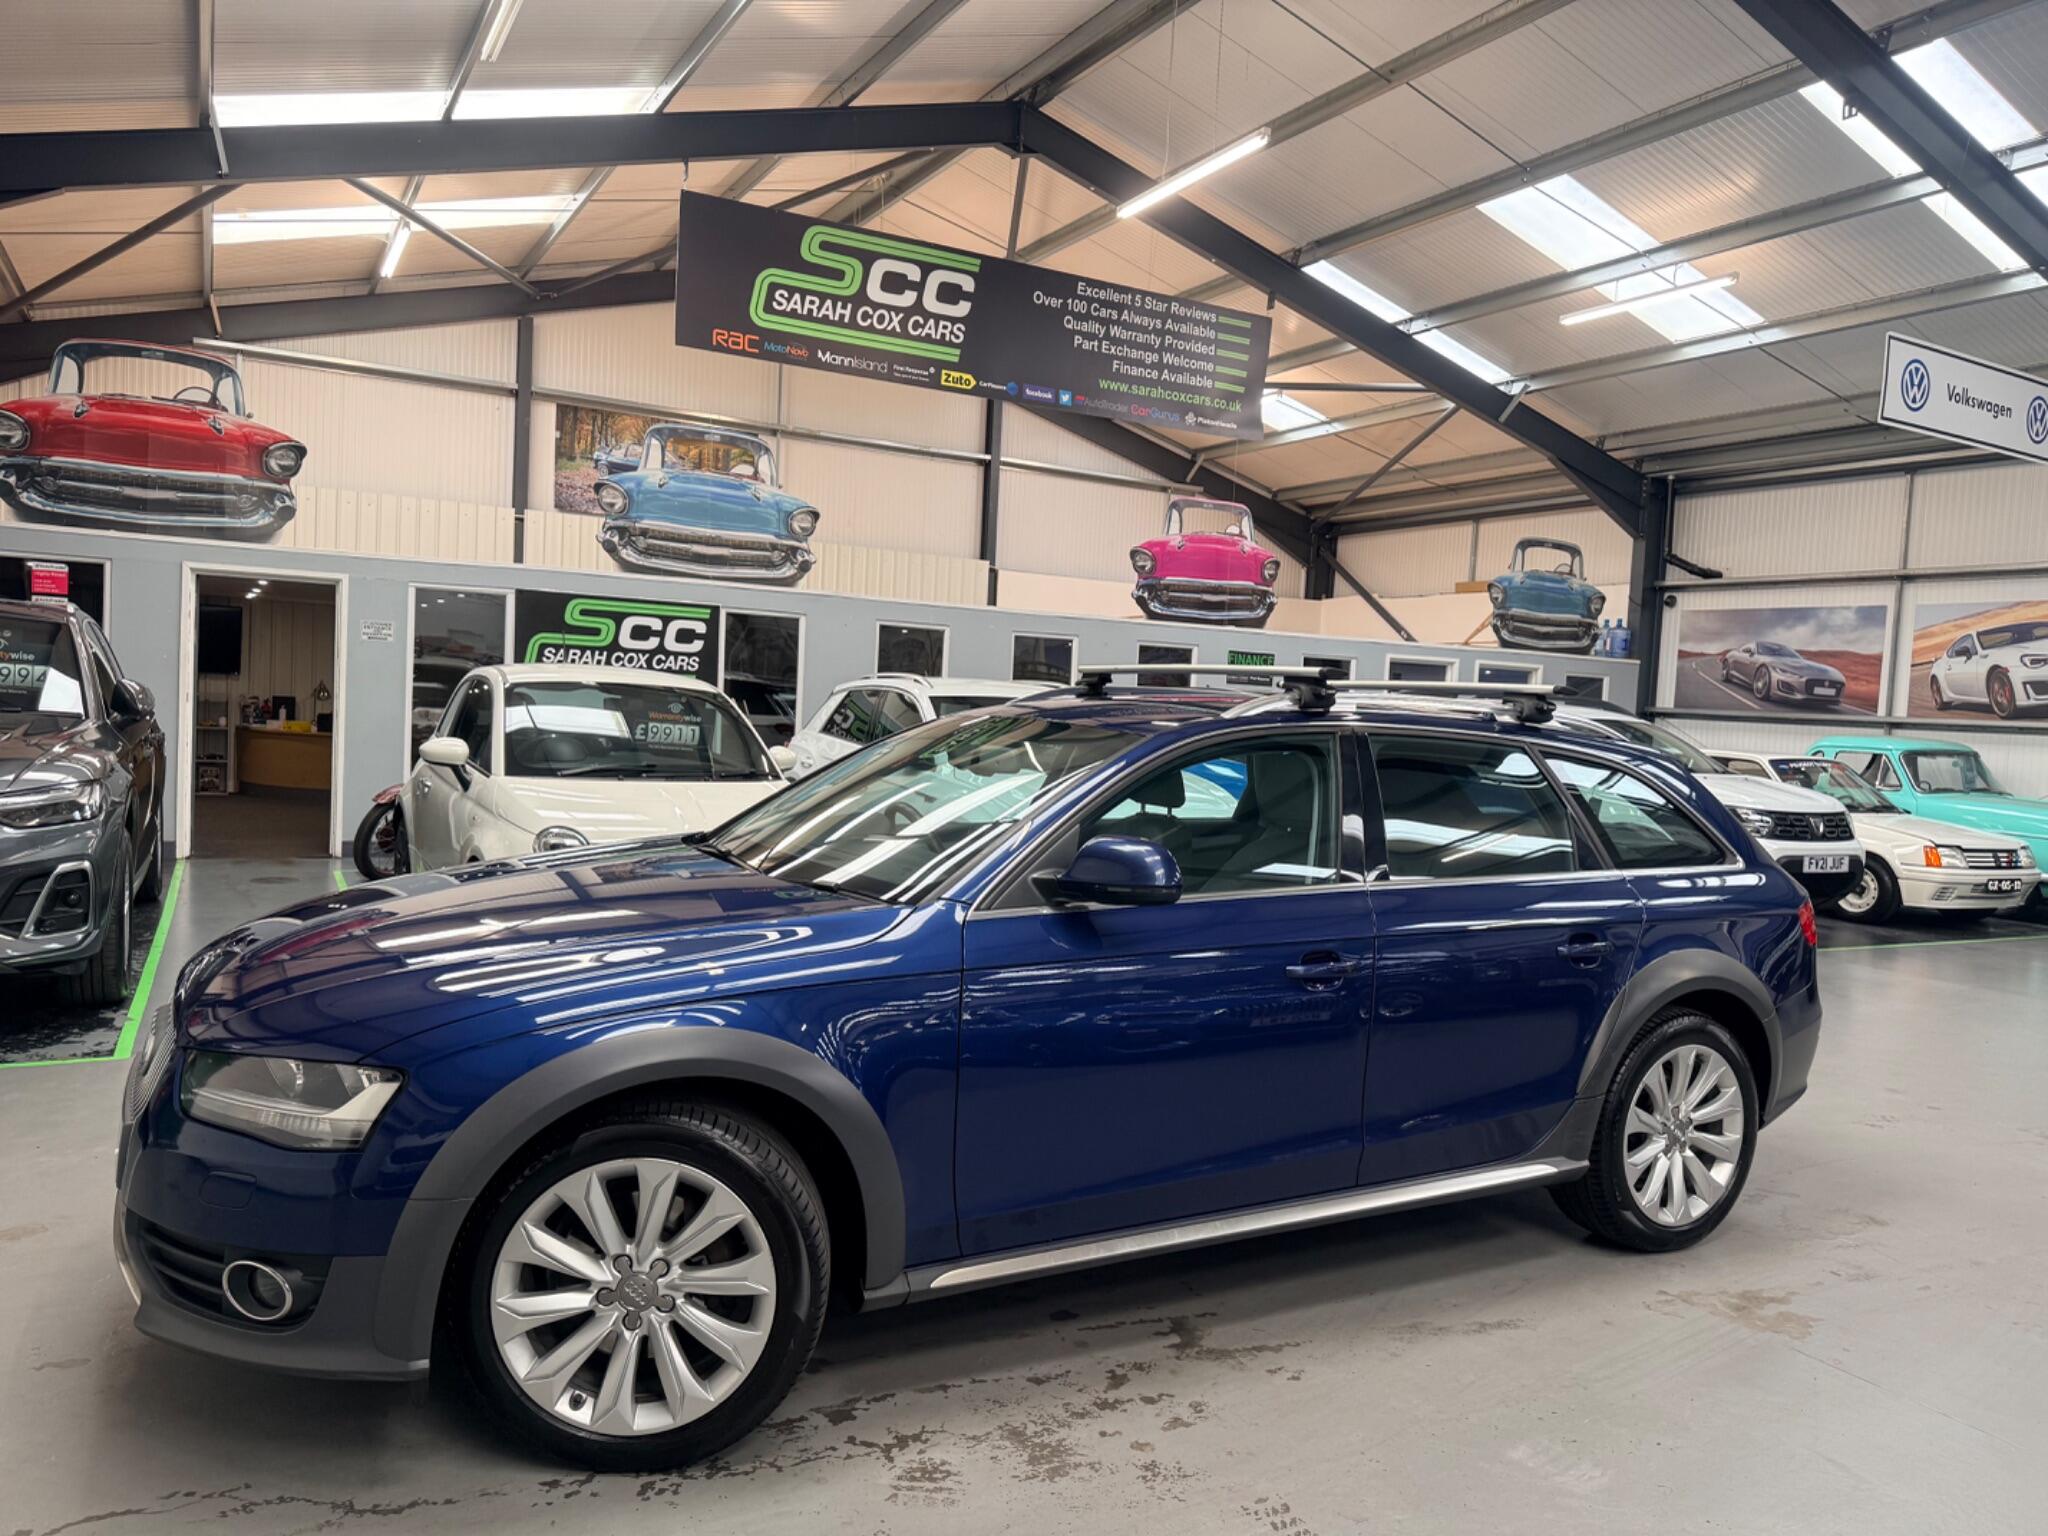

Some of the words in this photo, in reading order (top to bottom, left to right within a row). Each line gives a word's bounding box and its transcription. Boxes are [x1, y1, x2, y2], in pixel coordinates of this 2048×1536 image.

[772, 289, 852, 324] SARAH
[856, 305, 904, 333] COX
[907, 318, 966, 344] CARS
[1033, 290, 1064, 309] Over
[1066, 297, 1088, 314] 100
[1090, 303, 1118, 320] Cars
[1121, 309, 1162, 331] Always
[1164, 318, 1216, 340] Available
[1077, 281, 1132, 305] Excellent
[1134, 294, 1142, 307] 5
[1144, 296, 1168, 312] Star
[1171, 302, 1217, 323] Reviews
[1063, 315, 1106, 338] Quality
[1109, 324, 1162, 349] Warranty
[1164, 335, 1216, 356] Provided
[1073, 335, 1099, 352] Part
[1101, 340, 1159, 364] Exchange
[1162, 351, 1214, 372] Welcome
[943, 372, 972, 387] Zuto
[1112, 359, 1159, 380] Finance
[1161, 368, 1213, 389] Available
[1098, 378, 1243, 413] www.sarahcoxcars.co.uk
[1946, 382, 2013, 420] Volkswagen
[542, 647, 607, 666] SARAH
[610, 651, 650, 669] COX
[652, 654, 700, 672] CARS
[1228, 652, 1274, 665] FINANCE
